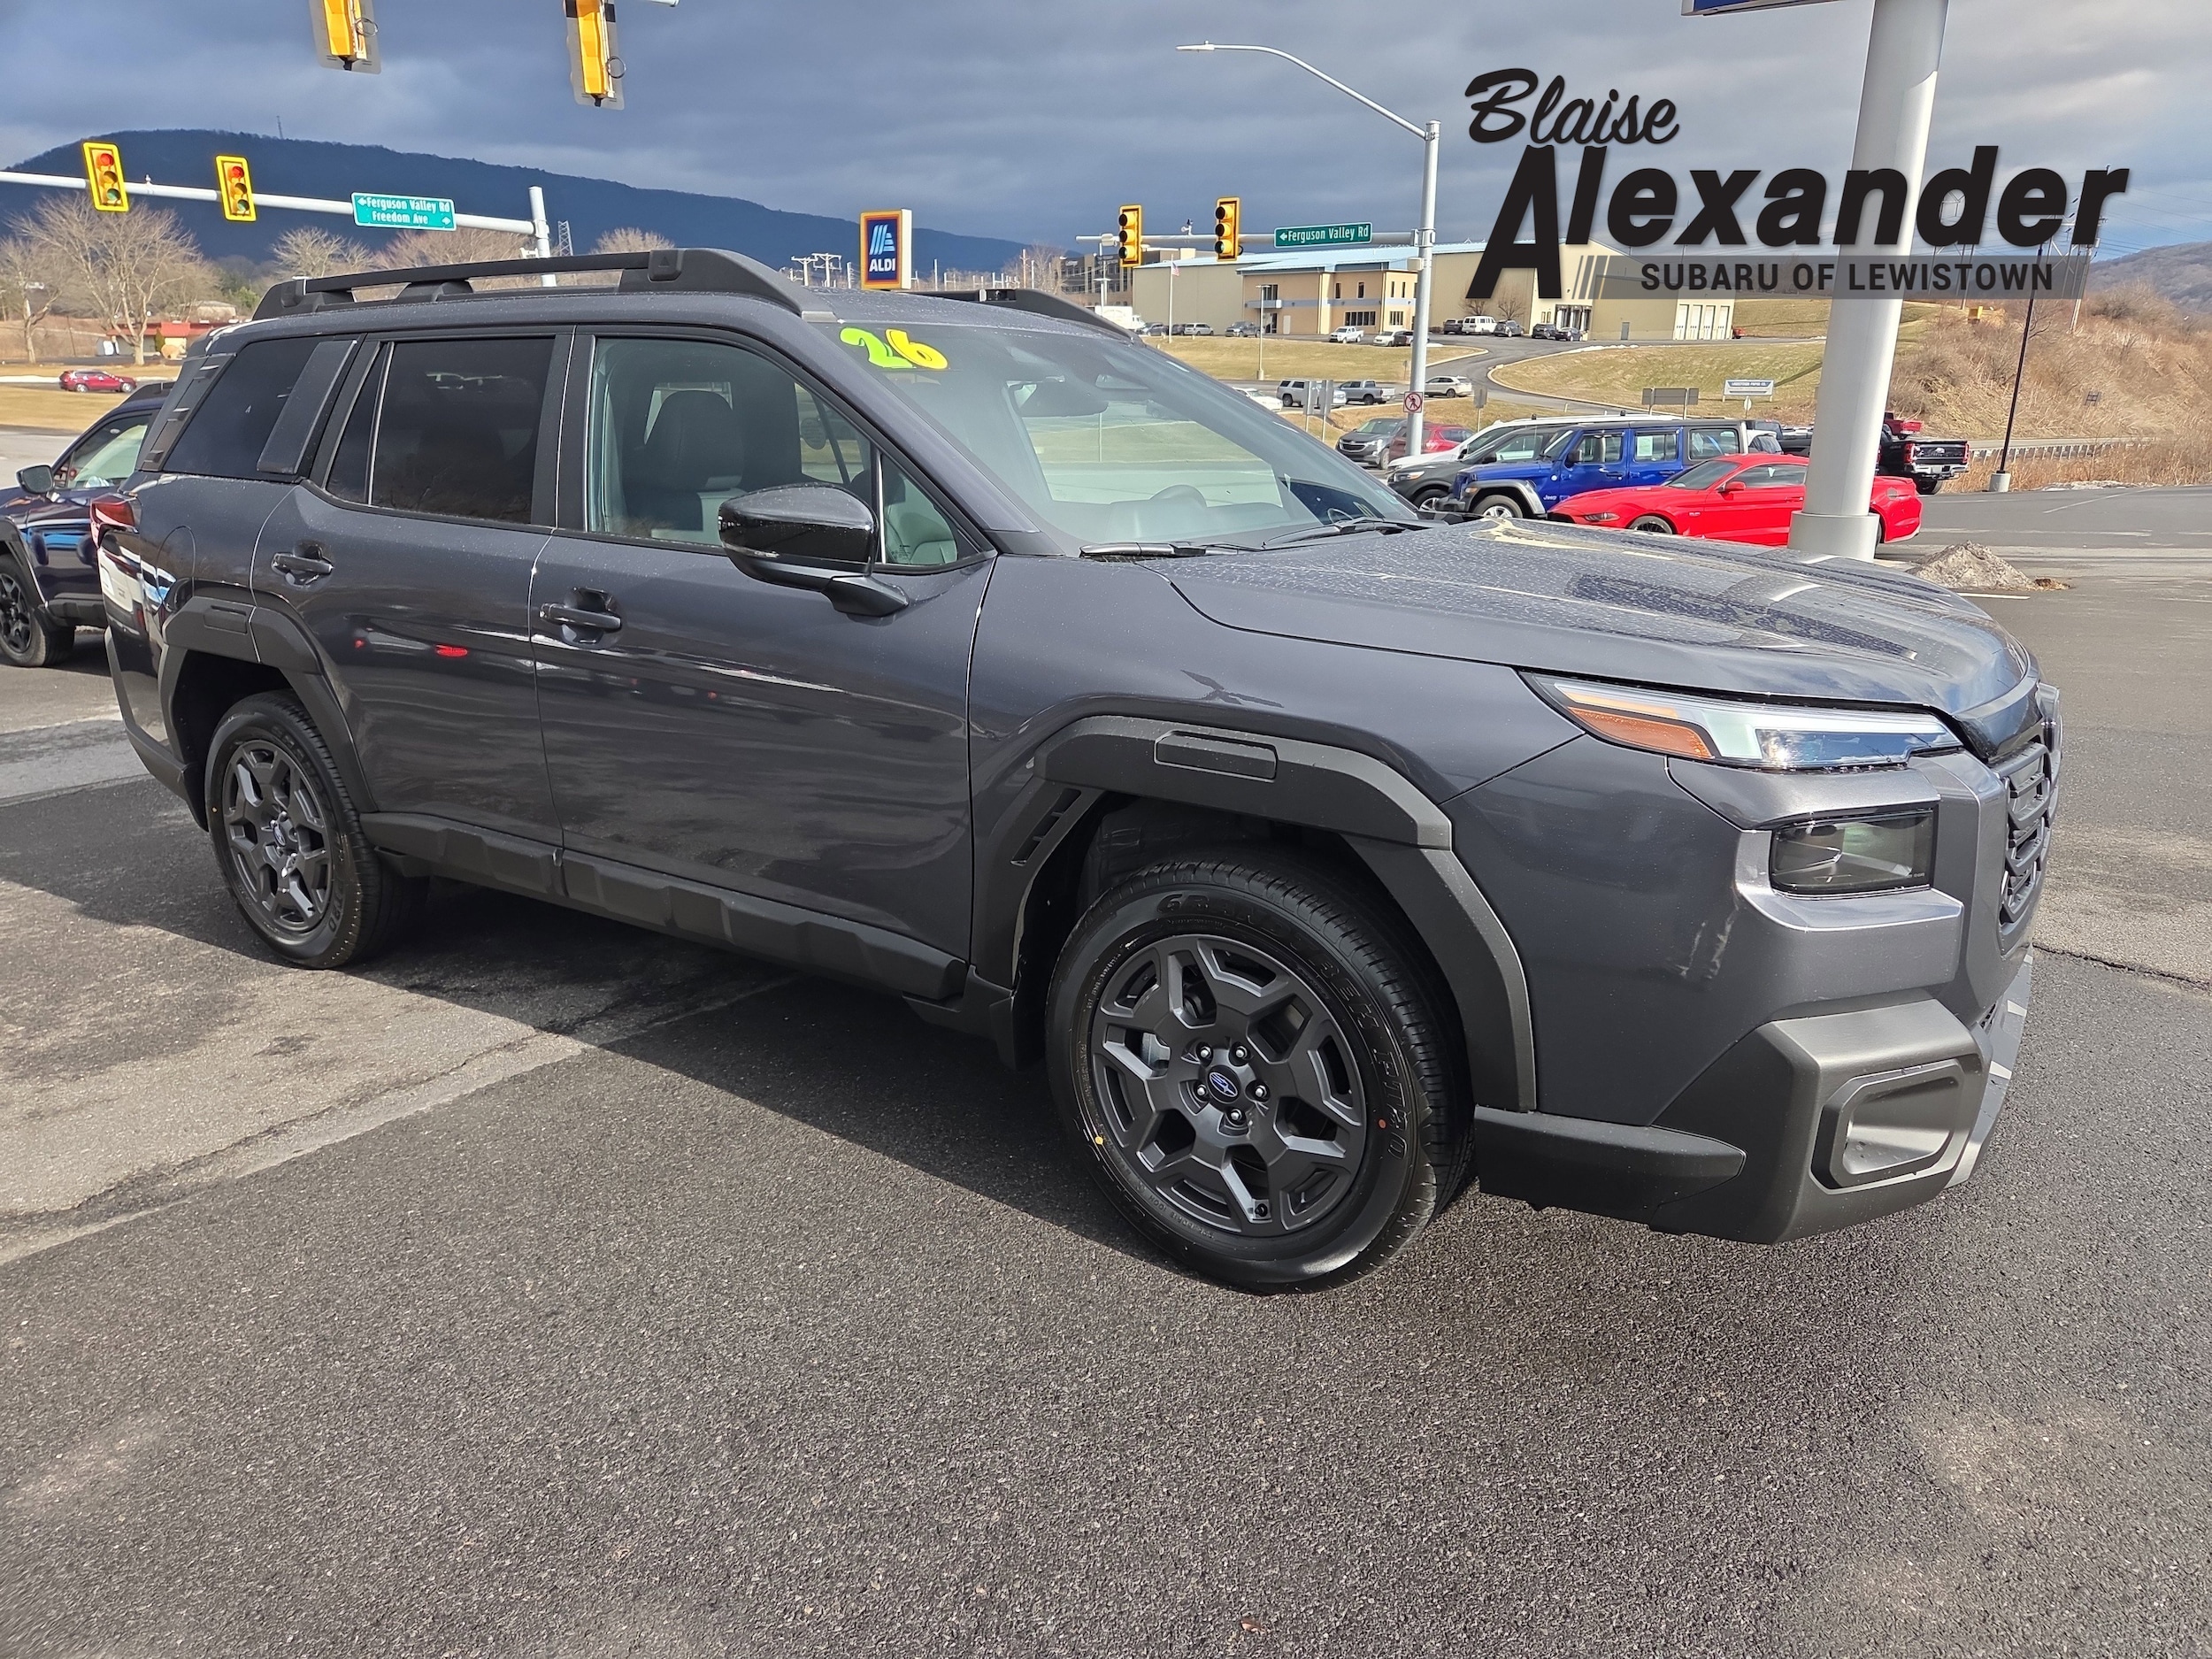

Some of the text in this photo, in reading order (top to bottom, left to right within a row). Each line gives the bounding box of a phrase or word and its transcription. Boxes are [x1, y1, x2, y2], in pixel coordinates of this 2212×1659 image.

[366, 197, 449, 213] Ferguson Valley Rd
[373, 211, 428, 224] Freedom Ave
[1288, 225, 1369, 243] Ferguson Valley Rd
[869, 258, 896, 272] ALDI
[839, 326, 949, 370] 26
